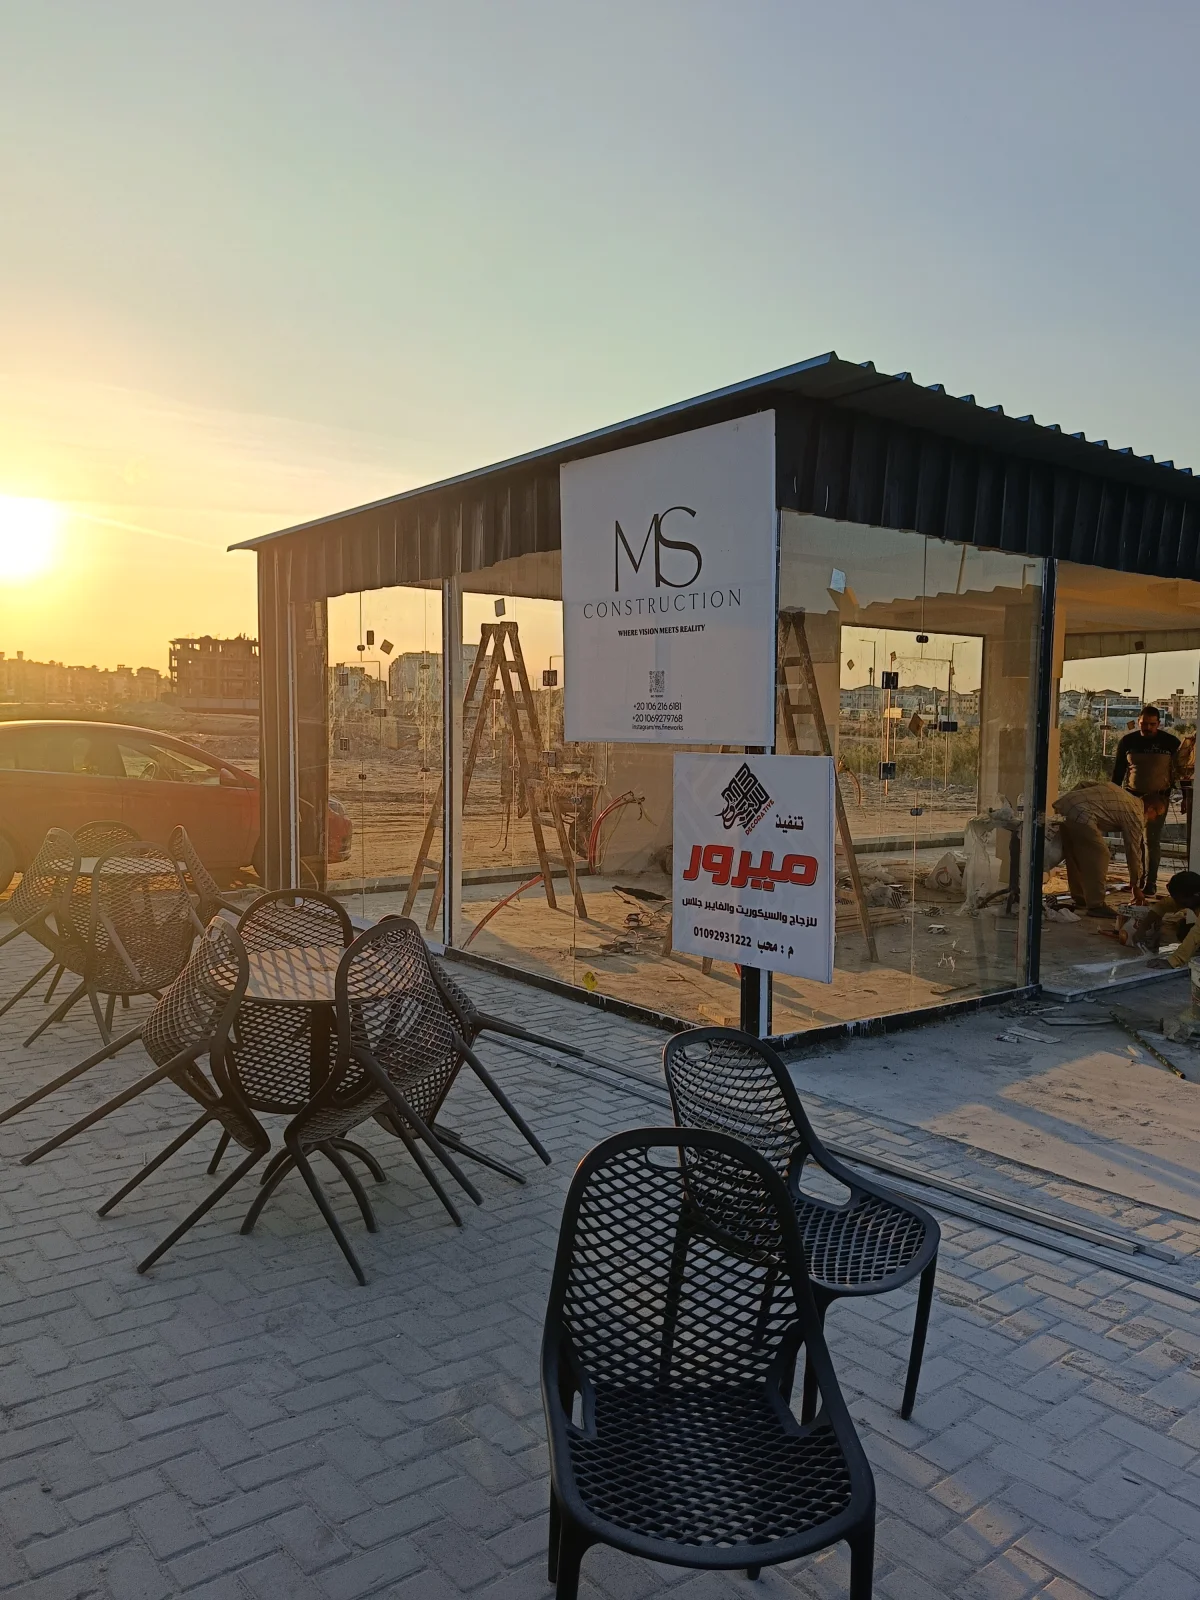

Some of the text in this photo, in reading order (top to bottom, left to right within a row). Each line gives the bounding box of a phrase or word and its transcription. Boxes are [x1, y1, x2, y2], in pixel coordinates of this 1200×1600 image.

[615, 506, 702, 592] MS
[583, 588, 742, 619] CONSTRUCTION
[617, 624, 706, 637] WHERE VISION MEETS REALITY
[744, 798, 775, 836] DECORATIVE
[775, 814, 804, 833] تنفيذ
[682, 844, 819, 892] ميرور
[682, 897, 818, 927] للزجاج والسيكوريت والفايبر جلاس
[693, 926, 752, 948] 01092931222
[757, 939, 778, 954] محب
